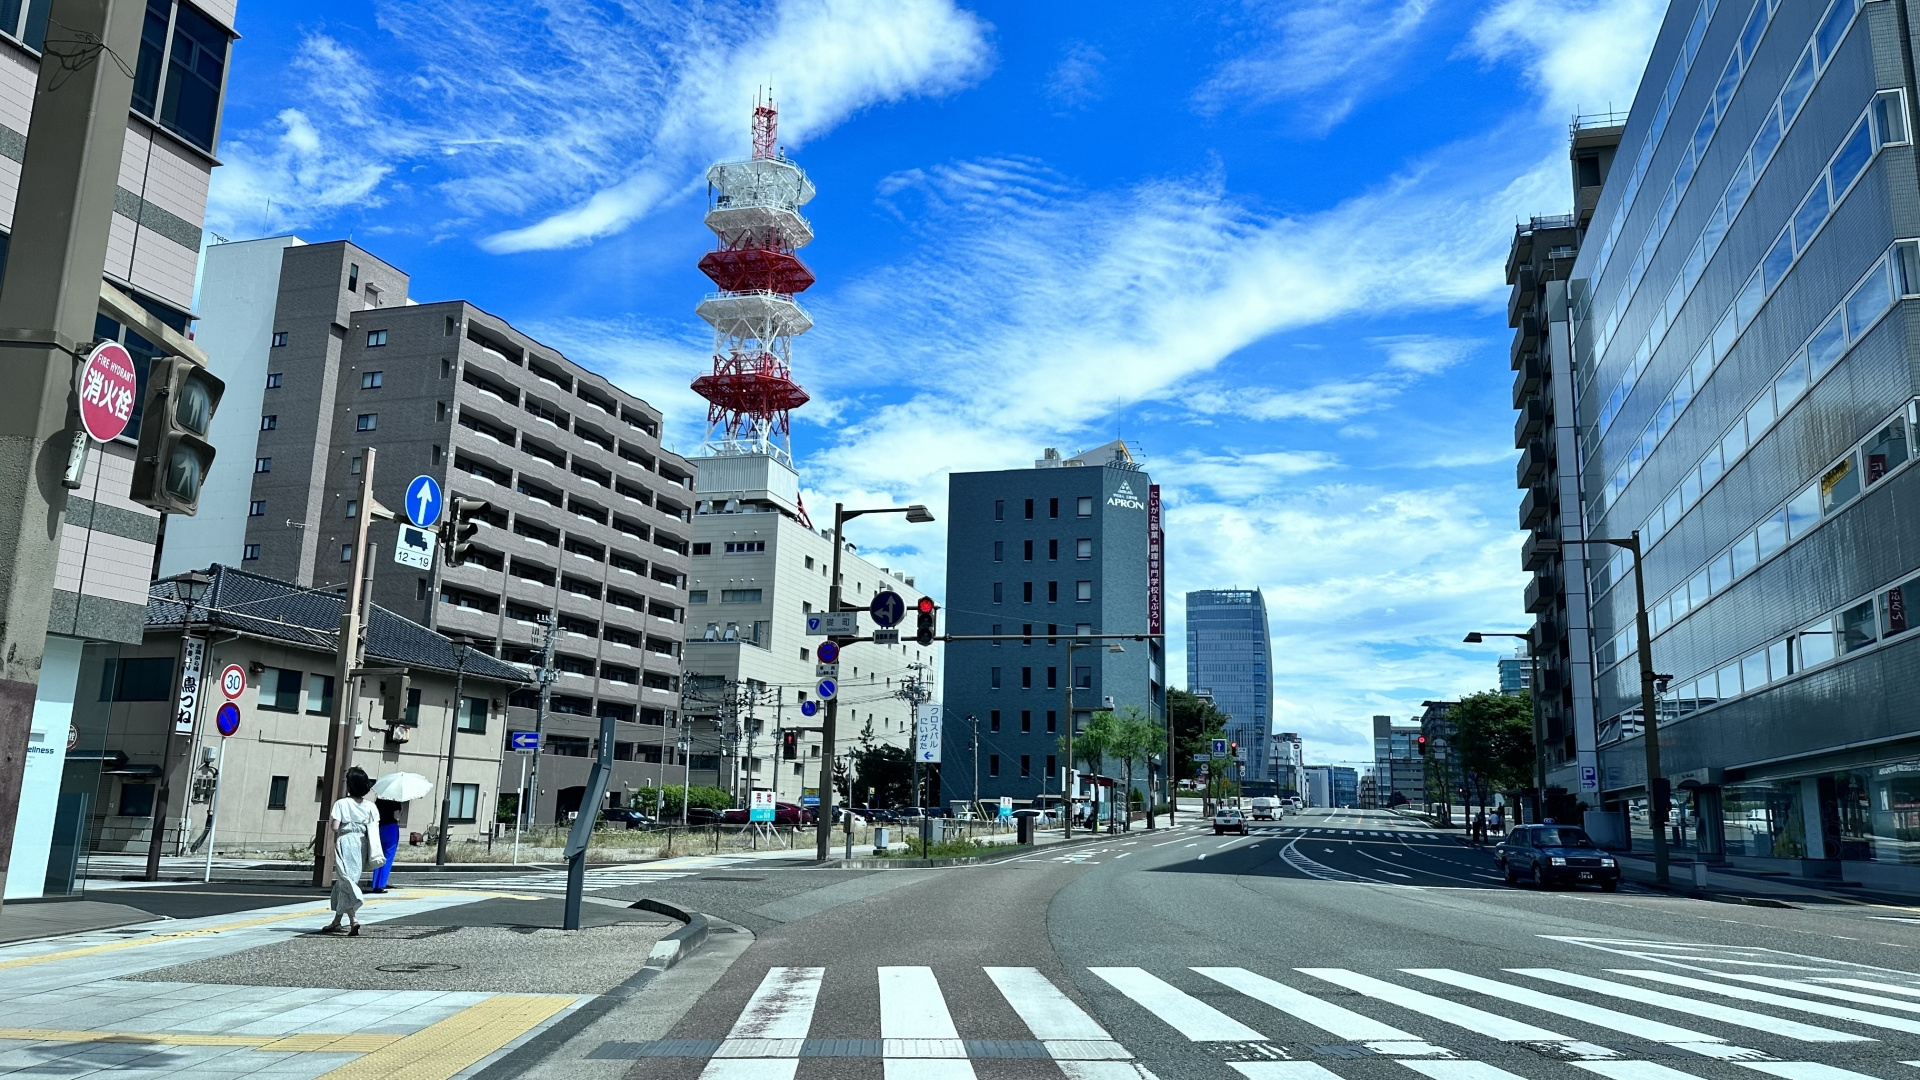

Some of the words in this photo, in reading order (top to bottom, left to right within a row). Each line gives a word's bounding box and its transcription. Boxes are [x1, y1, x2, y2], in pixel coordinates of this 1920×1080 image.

[97, 353, 111, 369] FIRE
[110, 361, 134, 384] HYDRANT
[83, 367, 133, 421] 消火栓
[1107, 497, 1144, 510] APRON
[811, 619, 817, 629] 7
[226, 674, 241, 691] 30
[920, 717, 929, 750] にいがた
[1582, 767, 1594, 780] P
